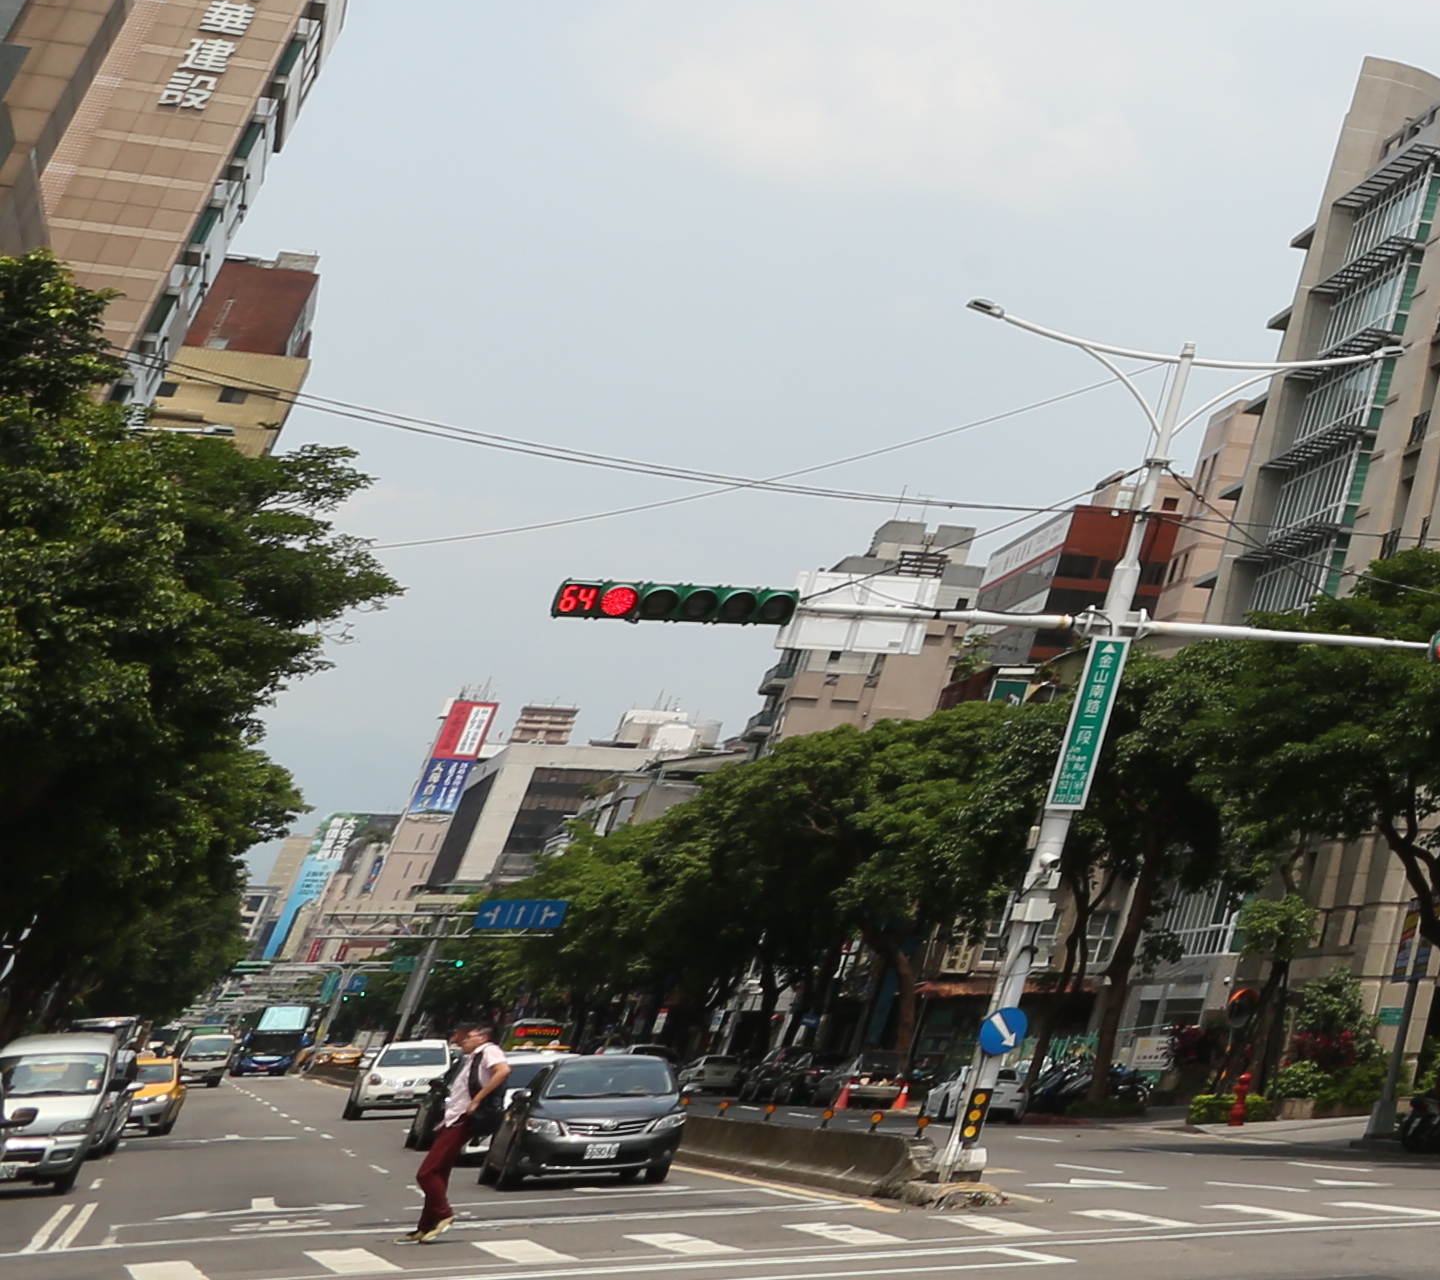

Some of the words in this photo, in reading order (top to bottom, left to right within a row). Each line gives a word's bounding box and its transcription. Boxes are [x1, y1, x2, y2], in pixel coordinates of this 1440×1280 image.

[558, 585, 598, 612] 64
[1076, 654, 1114, 745] 金山南路二段
